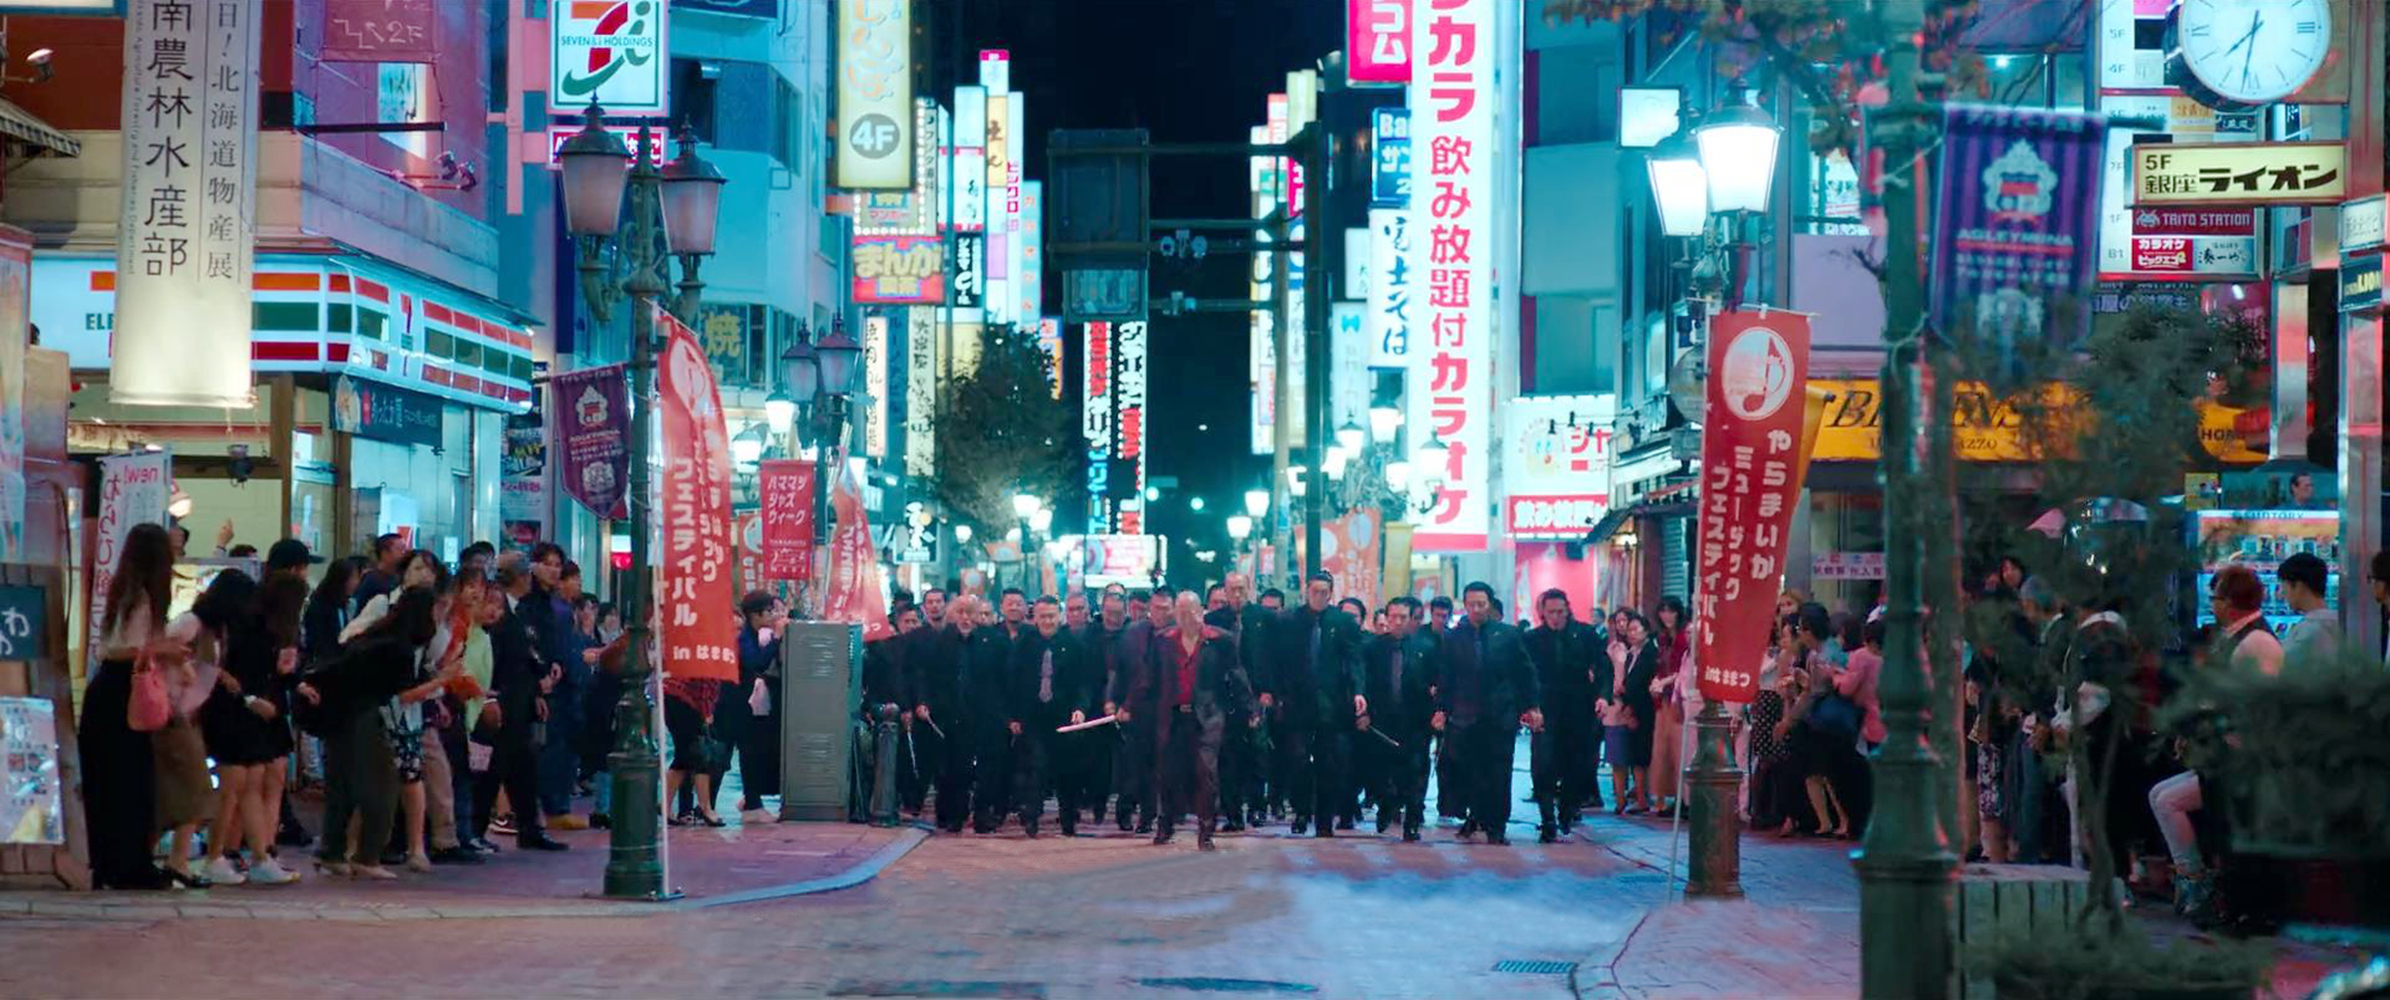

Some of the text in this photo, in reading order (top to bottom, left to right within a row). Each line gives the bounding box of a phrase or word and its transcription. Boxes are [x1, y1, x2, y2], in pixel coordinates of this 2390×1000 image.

[1371, 0, 1406, 64] コム
[851, 121, 896, 151] 4F
[2145, 155, 2172, 170] 5F
[2200, 213, 2250, 226] STATION
[2138, 239, 2186, 250] カラオケ
[768, 475, 807, 490] ハママツ
[768, 492, 796, 508] ジャズ
[1752, 429, 1793, 580] やらまいか
[768, 510, 806, 525] ウィーク
[1725, 445, 1753, 601] ミュージック
[672, 457, 699, 627] フェスティバル
